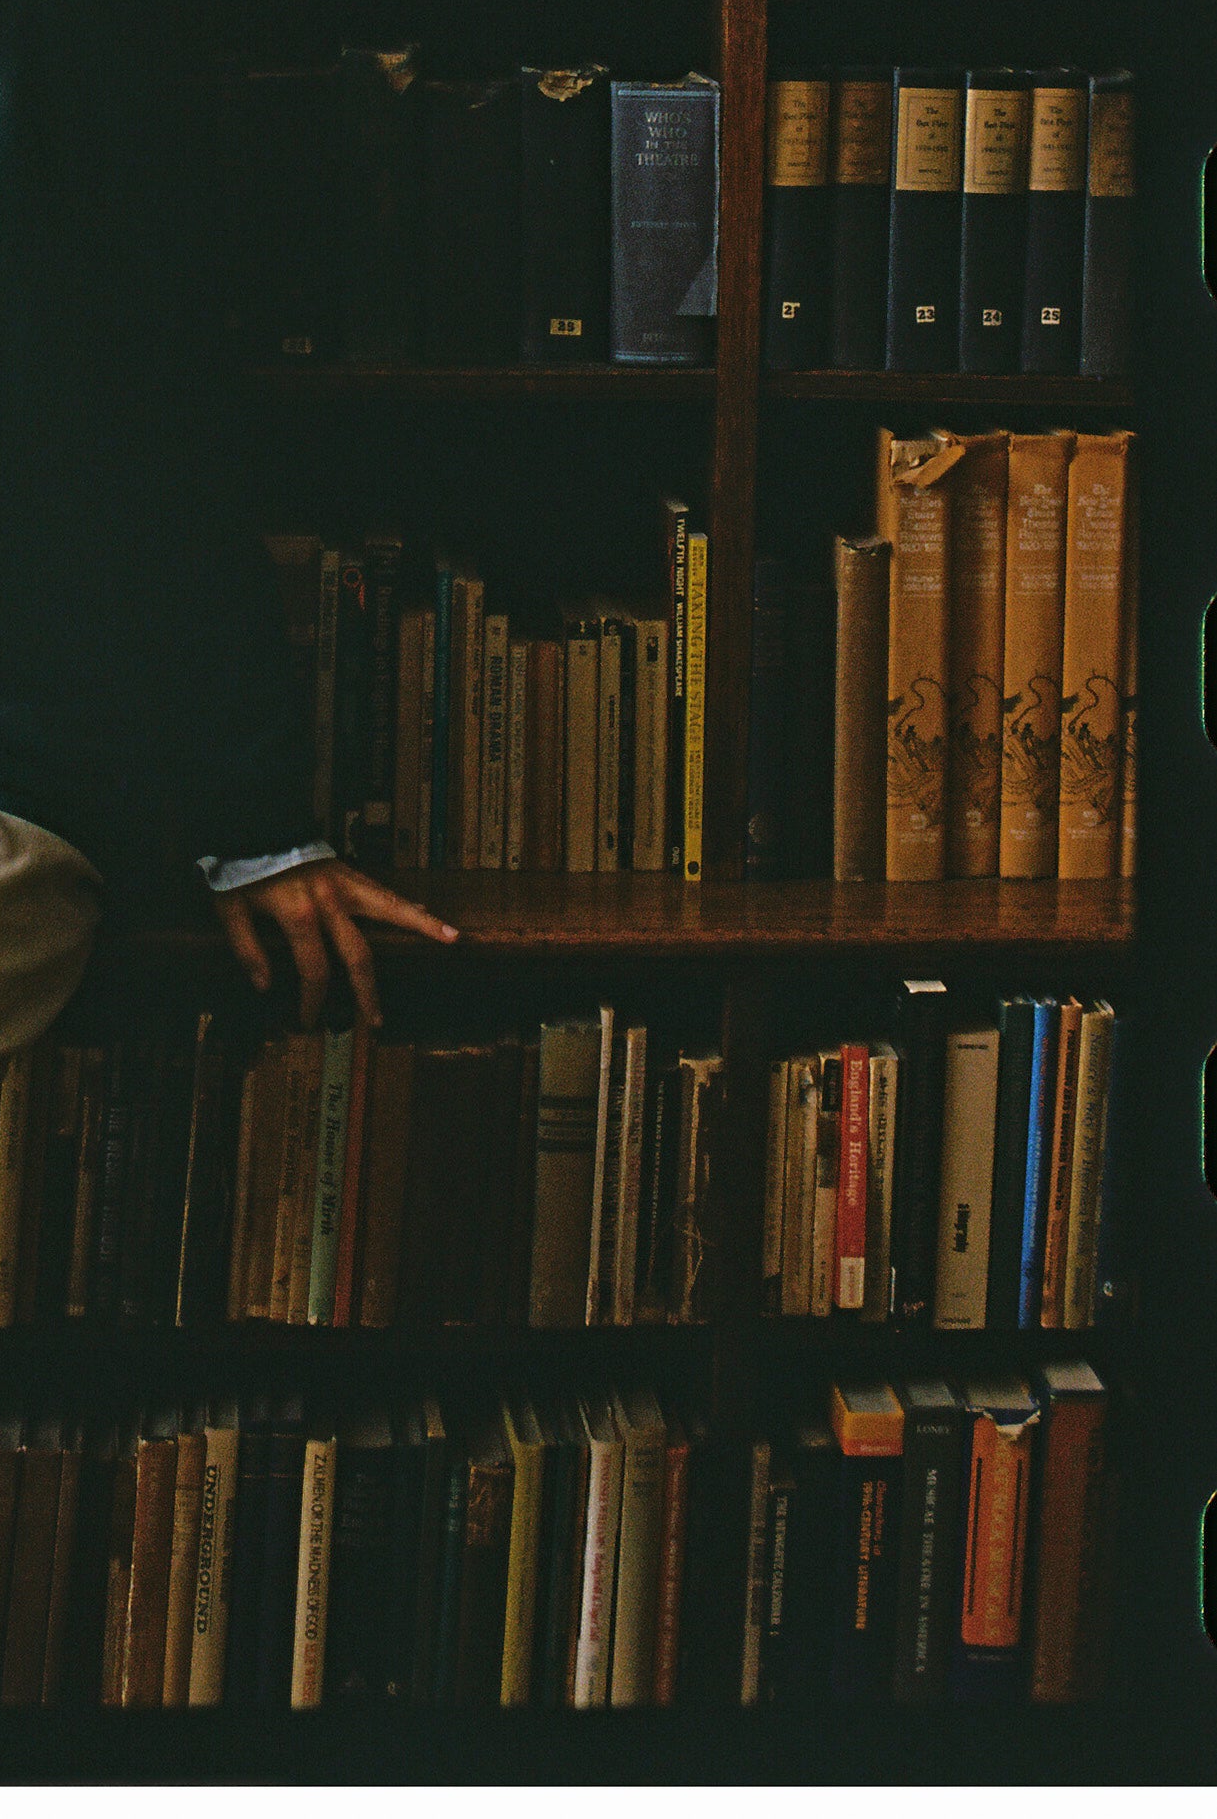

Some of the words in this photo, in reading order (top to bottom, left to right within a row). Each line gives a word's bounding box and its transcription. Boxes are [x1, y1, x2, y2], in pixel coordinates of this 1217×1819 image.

[646, 126, 688, 139] WHO
[635, 152, 699, 166] THEATRE
[916, 308, 934, 320] 23
[1043, 308, 1059, 320] 25
[676, 517, 685, 563] TWELFTH
[675, 565, 684, 595] NIGHT
[675, 600, 684, 636] WILLIAM
[691, 580, 704, 647] TAKING
[490, 656, 503, 706] ROMAN
[674, 637, 683, 695] SHAKESPEARE
[690, 649, 704, 681] THE
[490, 712, 503, 764] DRAMA
[689, 691, 702, 744] STAGE
[329, 1083, 342, 1111] The
[848, 1059, 863, 1134] England's
[325, 1116, 341, 1166] House
[320, 1170, 334, 1187] of
[846, 1140, 862, 1207] Heritage
[310, 1503, 324, 1519] OR
[776, 1495, 788, 1517] THE
[197, 1464, 218, 1634] UNDERGROUND
[310, 1520, 323, 1545] THE
[773, 1518, 786, 1570] NEWGATE
[307, 1546, 322, 1596] MADNESS
[307, 1597, 320, 1612] OF
[769, 1570, 784, 1625] CALENDAR
[855, 1564, 870, 1629] LITERATURE
[305, 1613, 319, 1640] GOD
